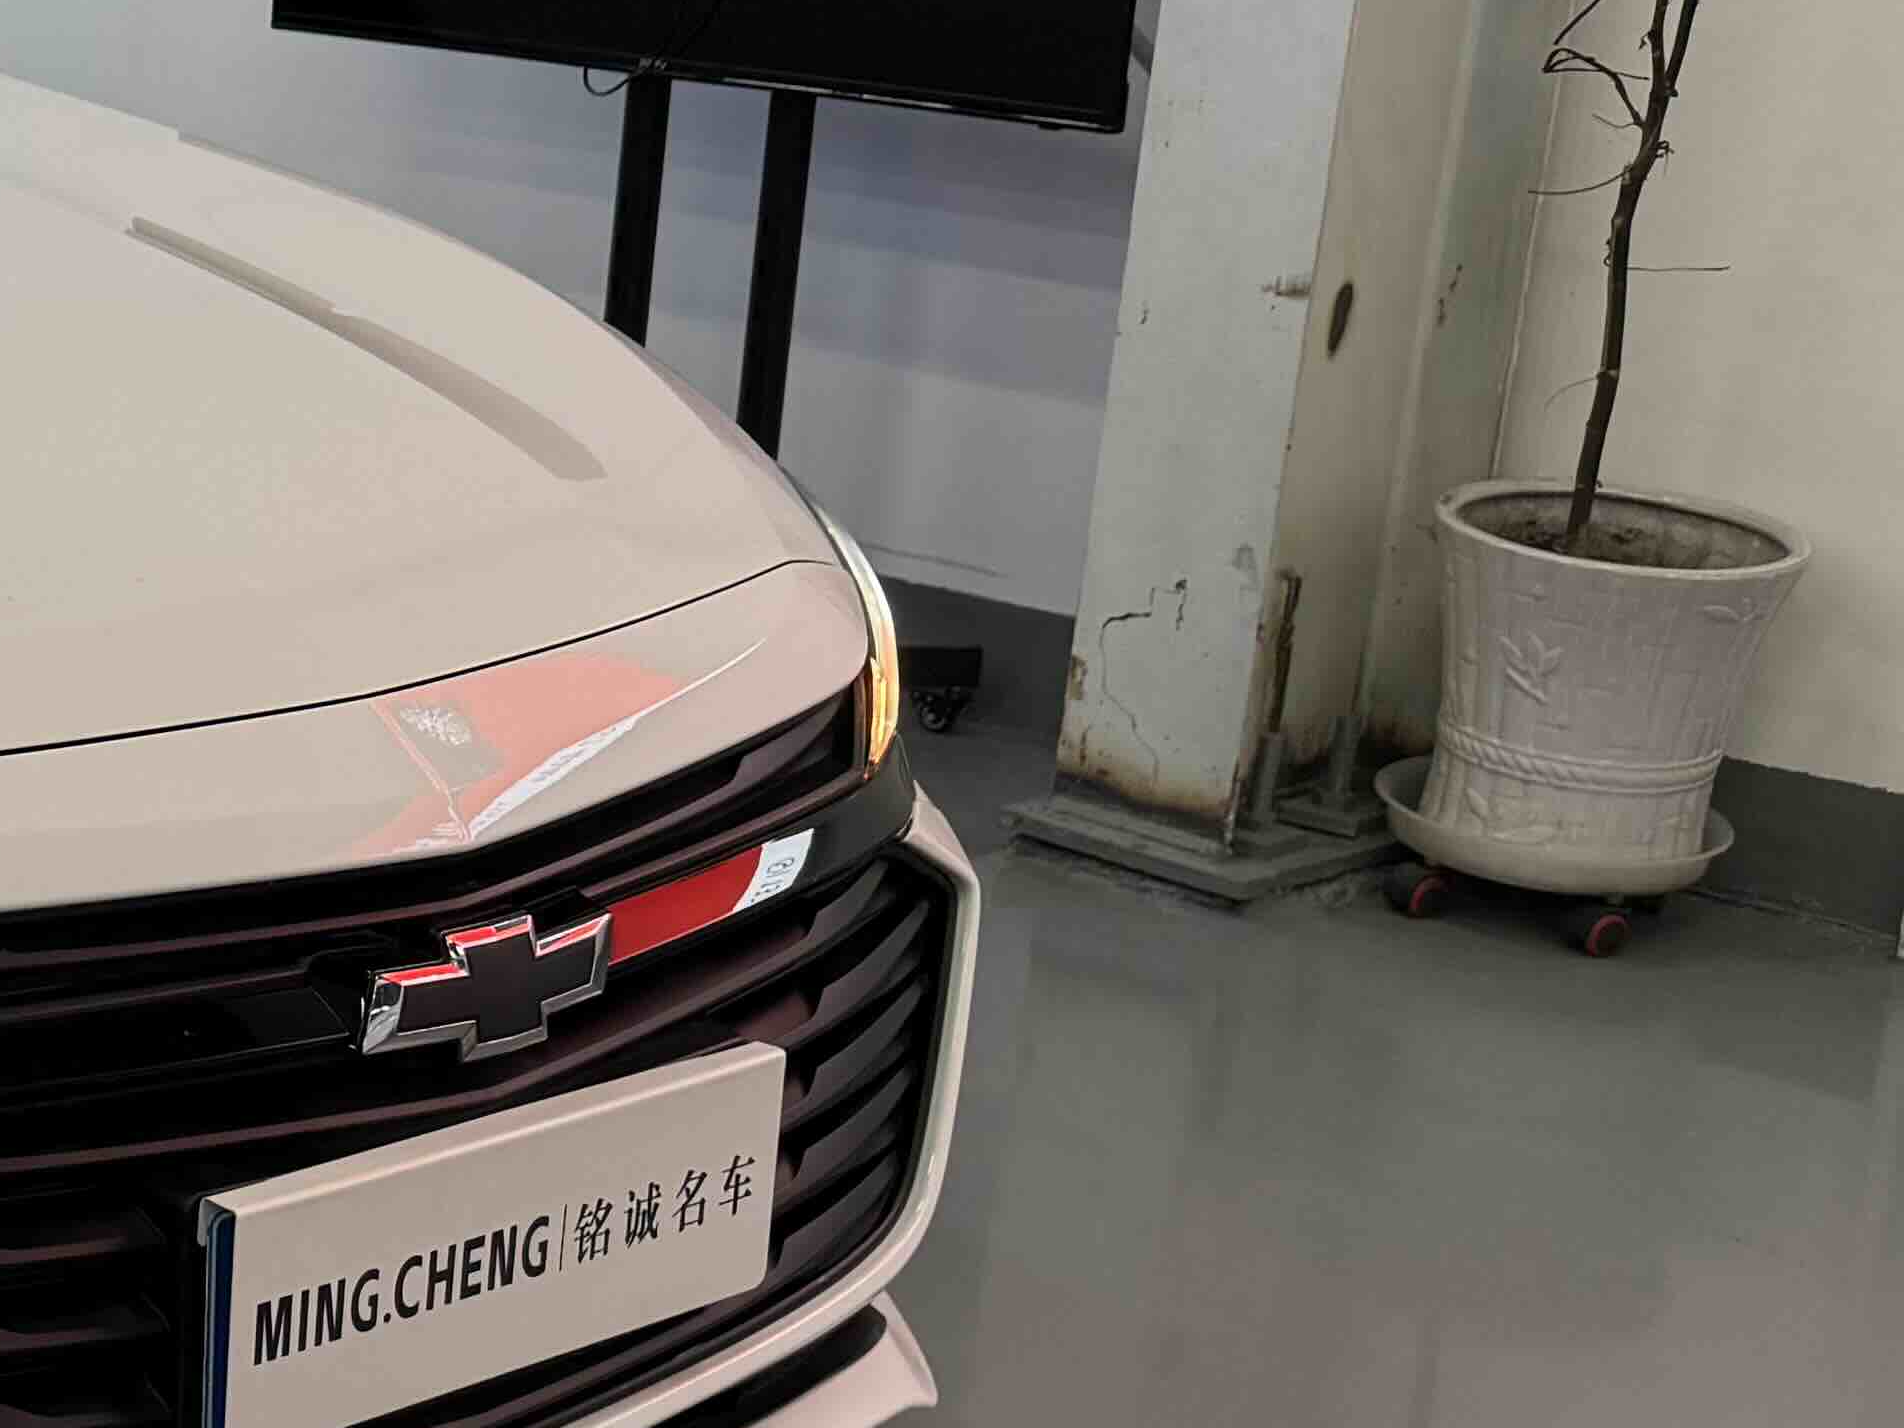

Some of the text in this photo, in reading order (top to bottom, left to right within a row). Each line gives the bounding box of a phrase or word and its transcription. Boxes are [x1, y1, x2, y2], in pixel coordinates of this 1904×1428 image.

[252, 1154, 756, 1366] MING.CHENG 铭诚名车
